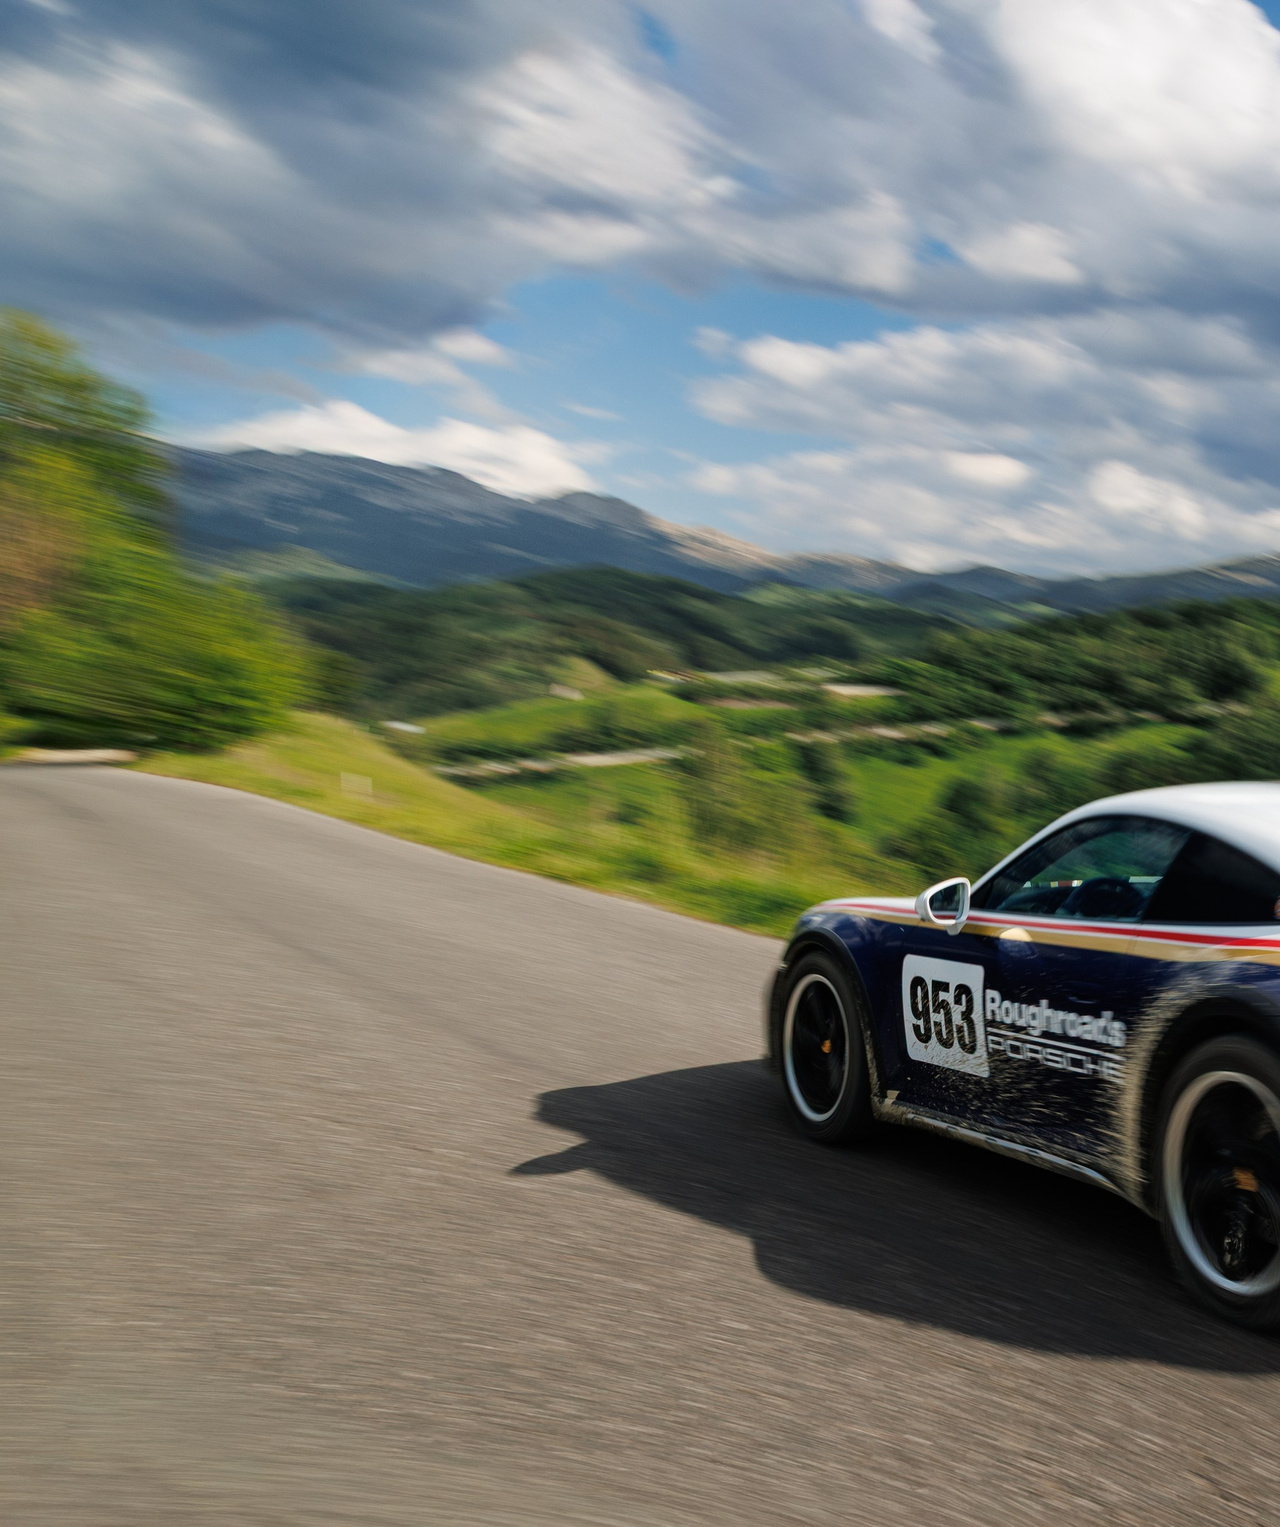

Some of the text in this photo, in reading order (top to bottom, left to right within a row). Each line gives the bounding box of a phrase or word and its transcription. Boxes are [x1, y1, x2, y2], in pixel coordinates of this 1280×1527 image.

[910, 975, 977, 1054] 953
[985, 989, 1127, 1047] Roughroads
[987, 1035, 1125, 1084] PORSCHE
